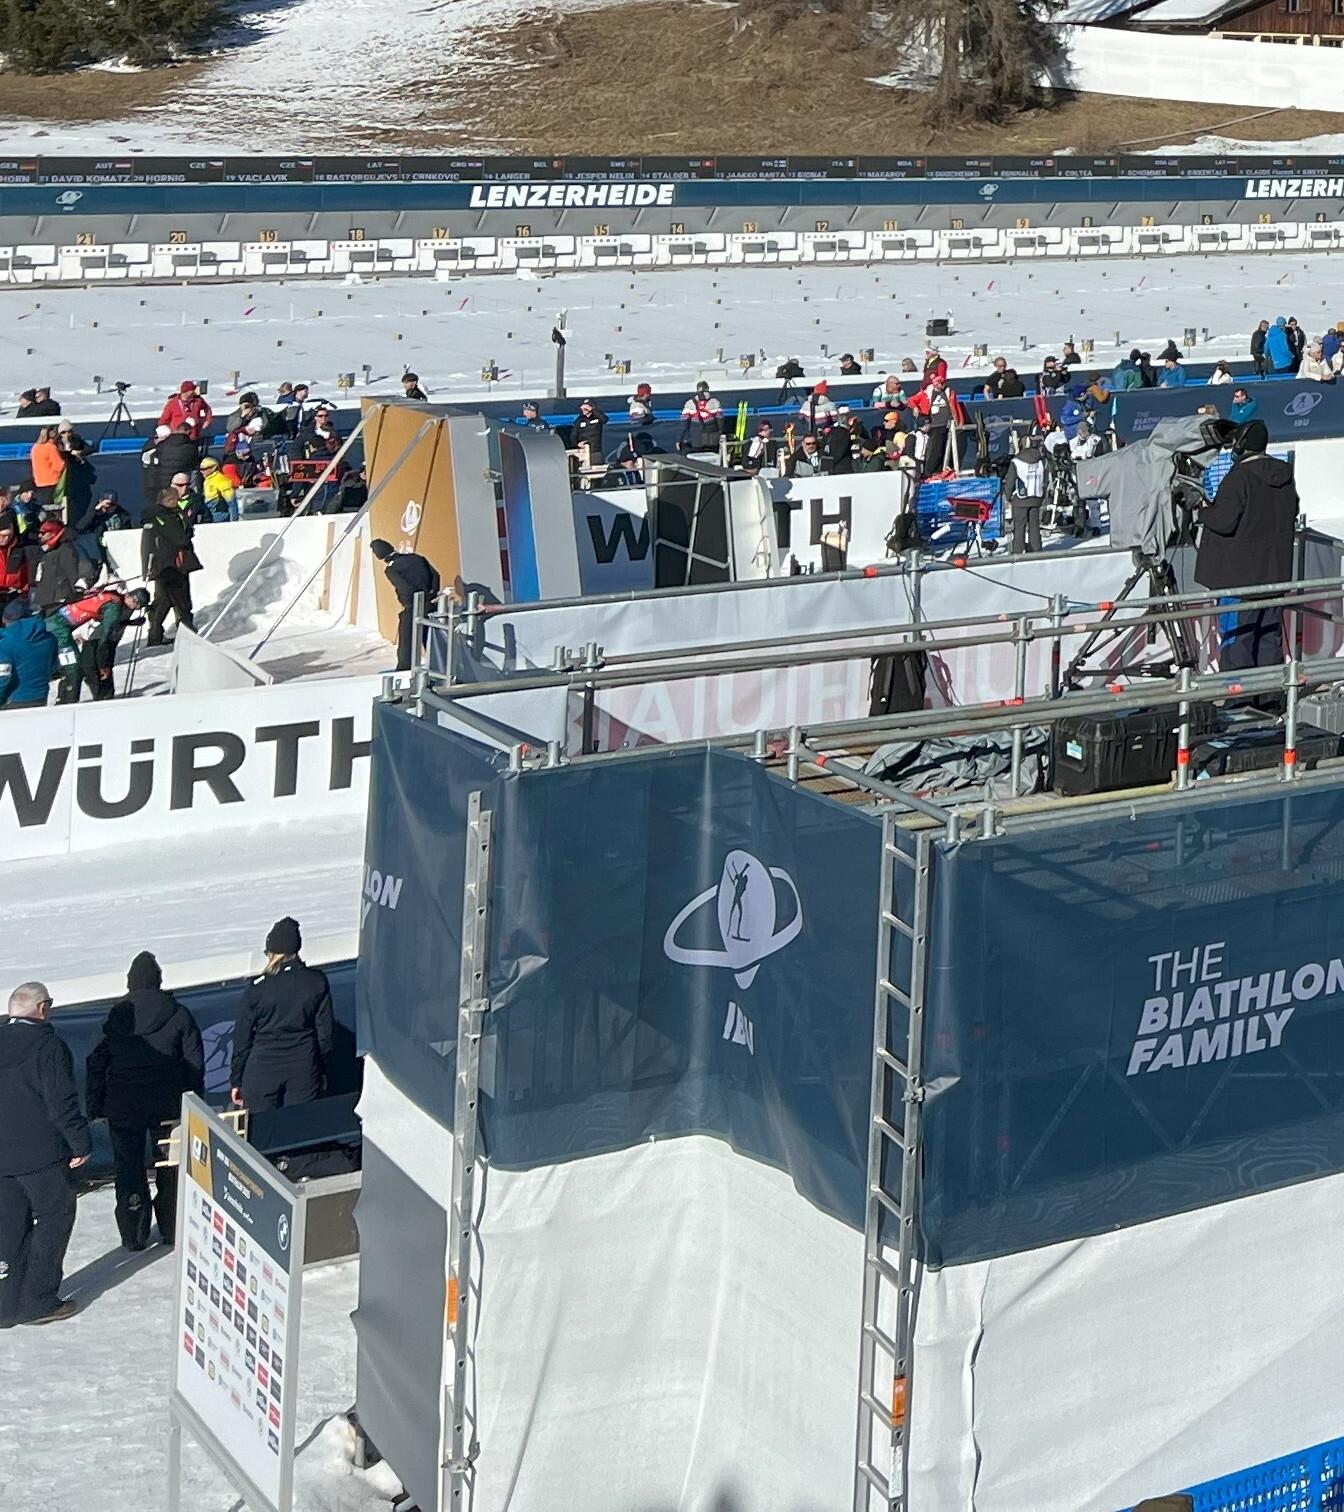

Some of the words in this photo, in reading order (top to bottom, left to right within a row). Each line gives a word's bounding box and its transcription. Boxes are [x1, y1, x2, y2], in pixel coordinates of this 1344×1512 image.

[51, 175, 84, 183] DAVID
[86, 175, 131, 183] KOMATZ
[470, 184, 675, 208] LENZERHEIDE
[1084, 218, 1091, 227] 8
[1145, 217, 1151, 226] 7
[1204, 216, 1211, 225] 6
[1262, 215, 1268, 224] 5
[1317, 214, 1324, 223] 4
[745, 223, 756, 232] 13
[817, 222, 828, 231] 12
[885, 221, 896, 230] 11
[952, 220, 963, 229] 10
[1020, 219, 1026, 228] 9
[516, 227, 530, 237] 16
[595, 226, 608, 236] 15
[672, 224, 683, 234] 14
[170, 233, 186, 243] 20
[262, 232, 276, 241] 19
[351, 230, 363, 240] 18
[434, 229, 448, 239] 17
[79, 235, 94, 244] 21
[1148, 941, 1226, 992] THE
[1126, 1007, 1295, 1076] FAMILY
